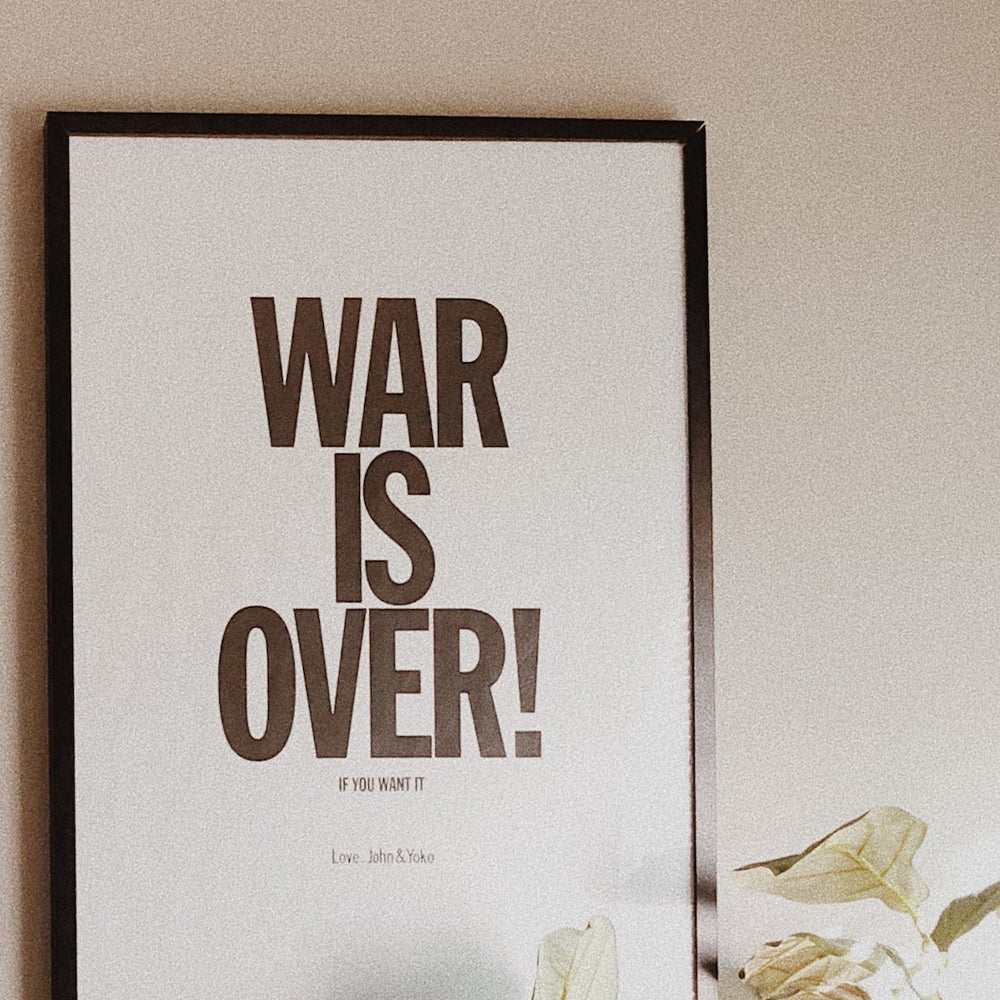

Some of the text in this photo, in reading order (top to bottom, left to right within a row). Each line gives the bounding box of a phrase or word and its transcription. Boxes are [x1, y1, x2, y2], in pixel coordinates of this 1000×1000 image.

[250, 297, 509, 448] WAR
[334, 450, 436, 606] IS
[218, 605, 542, 762] OVER!
[338, 776, 425, 793] IF YOU WANT IT
